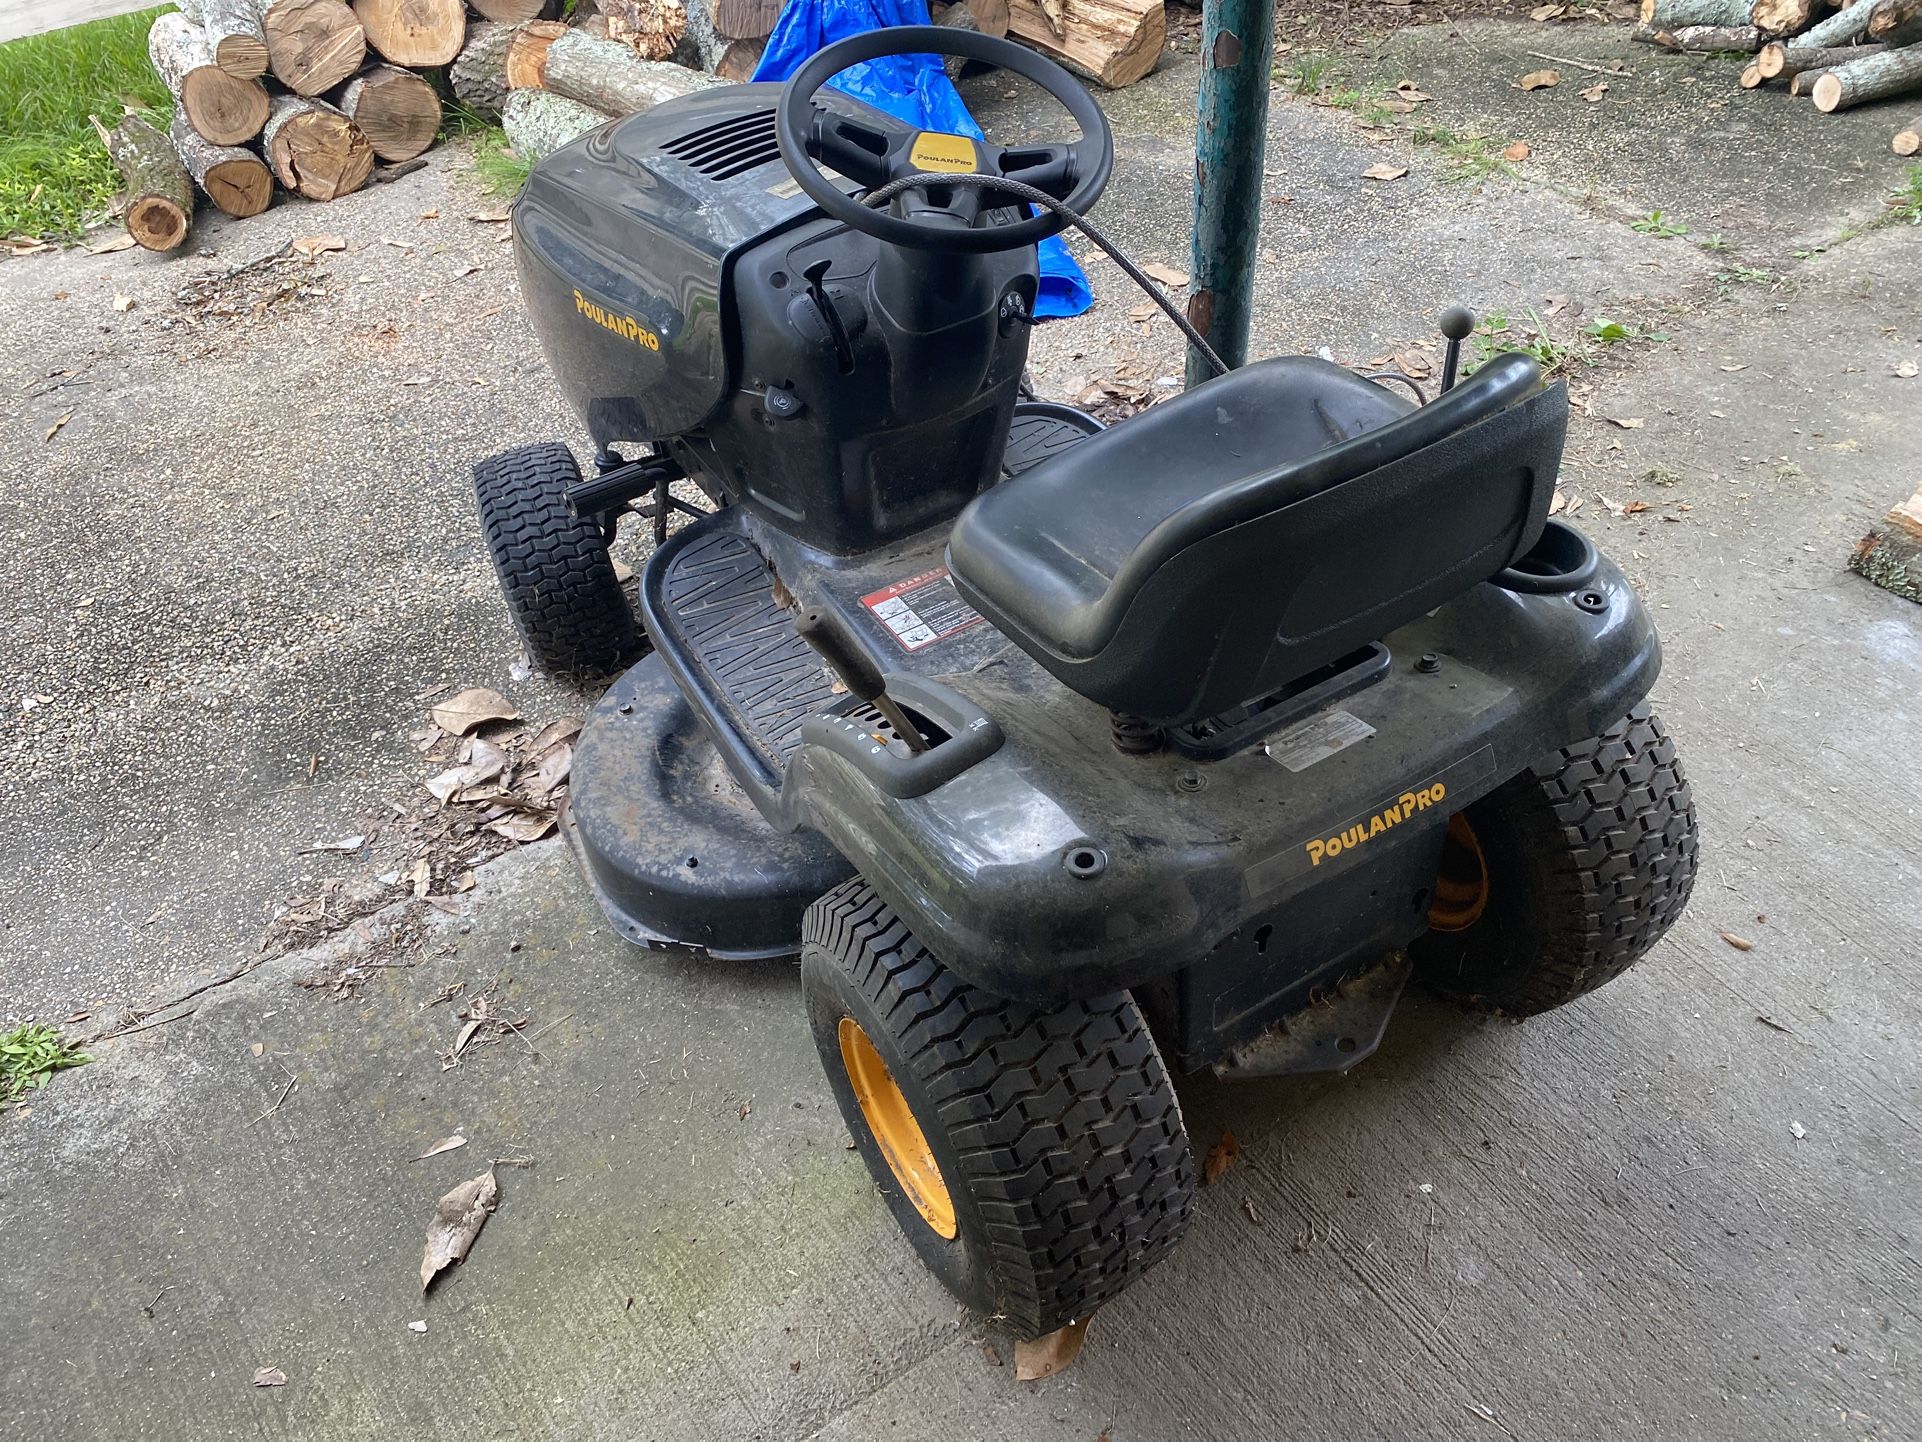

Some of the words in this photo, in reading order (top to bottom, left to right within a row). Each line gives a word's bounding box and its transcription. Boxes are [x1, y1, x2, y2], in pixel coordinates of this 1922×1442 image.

[916, 153, 973, 166] POULANPRO
[573, 288, 660, 352] POULANPRO
[899, 567, 943, 588] DANGER
[1305, 782, 1447, 867] POULANPRO
